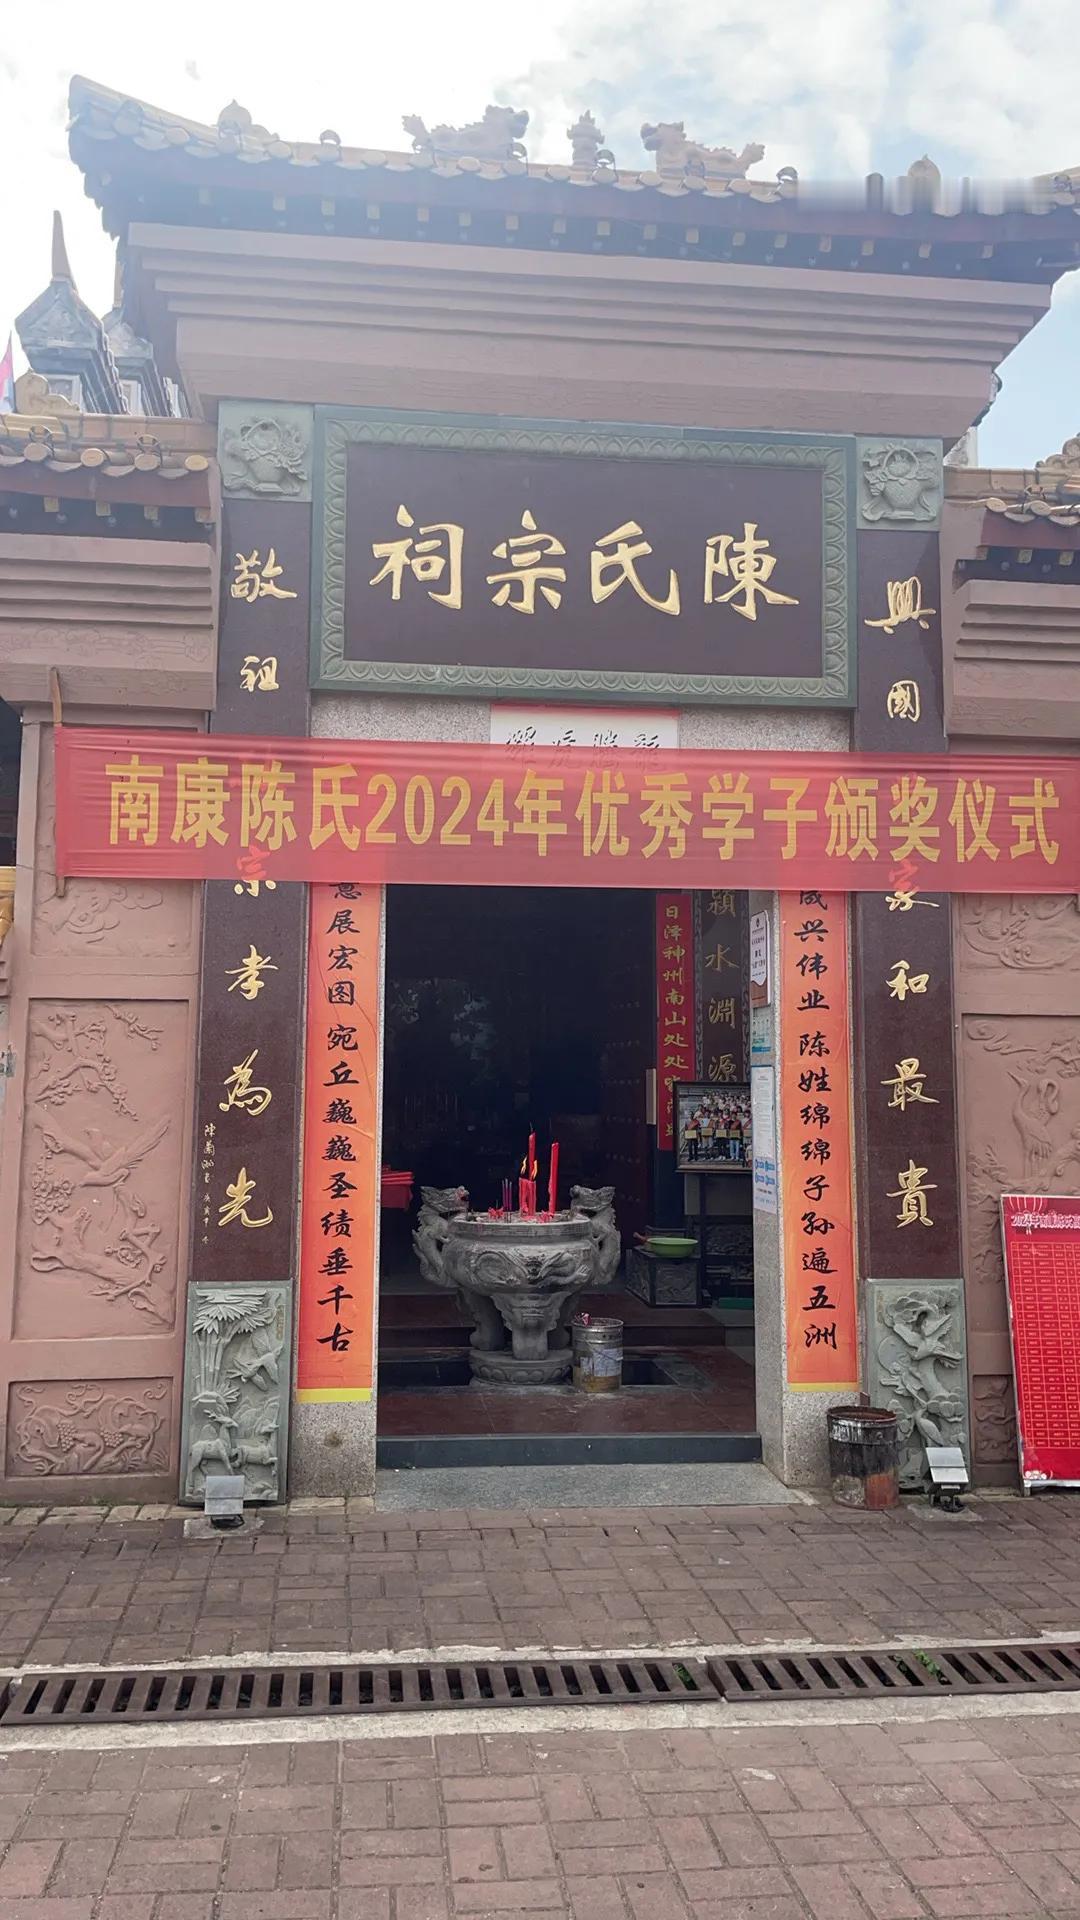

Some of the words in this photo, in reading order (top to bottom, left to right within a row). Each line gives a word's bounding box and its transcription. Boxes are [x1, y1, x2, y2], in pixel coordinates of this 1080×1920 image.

[105, 755, 1060, 864] 南康陈氏2024年优秀学子颁奖仪式
